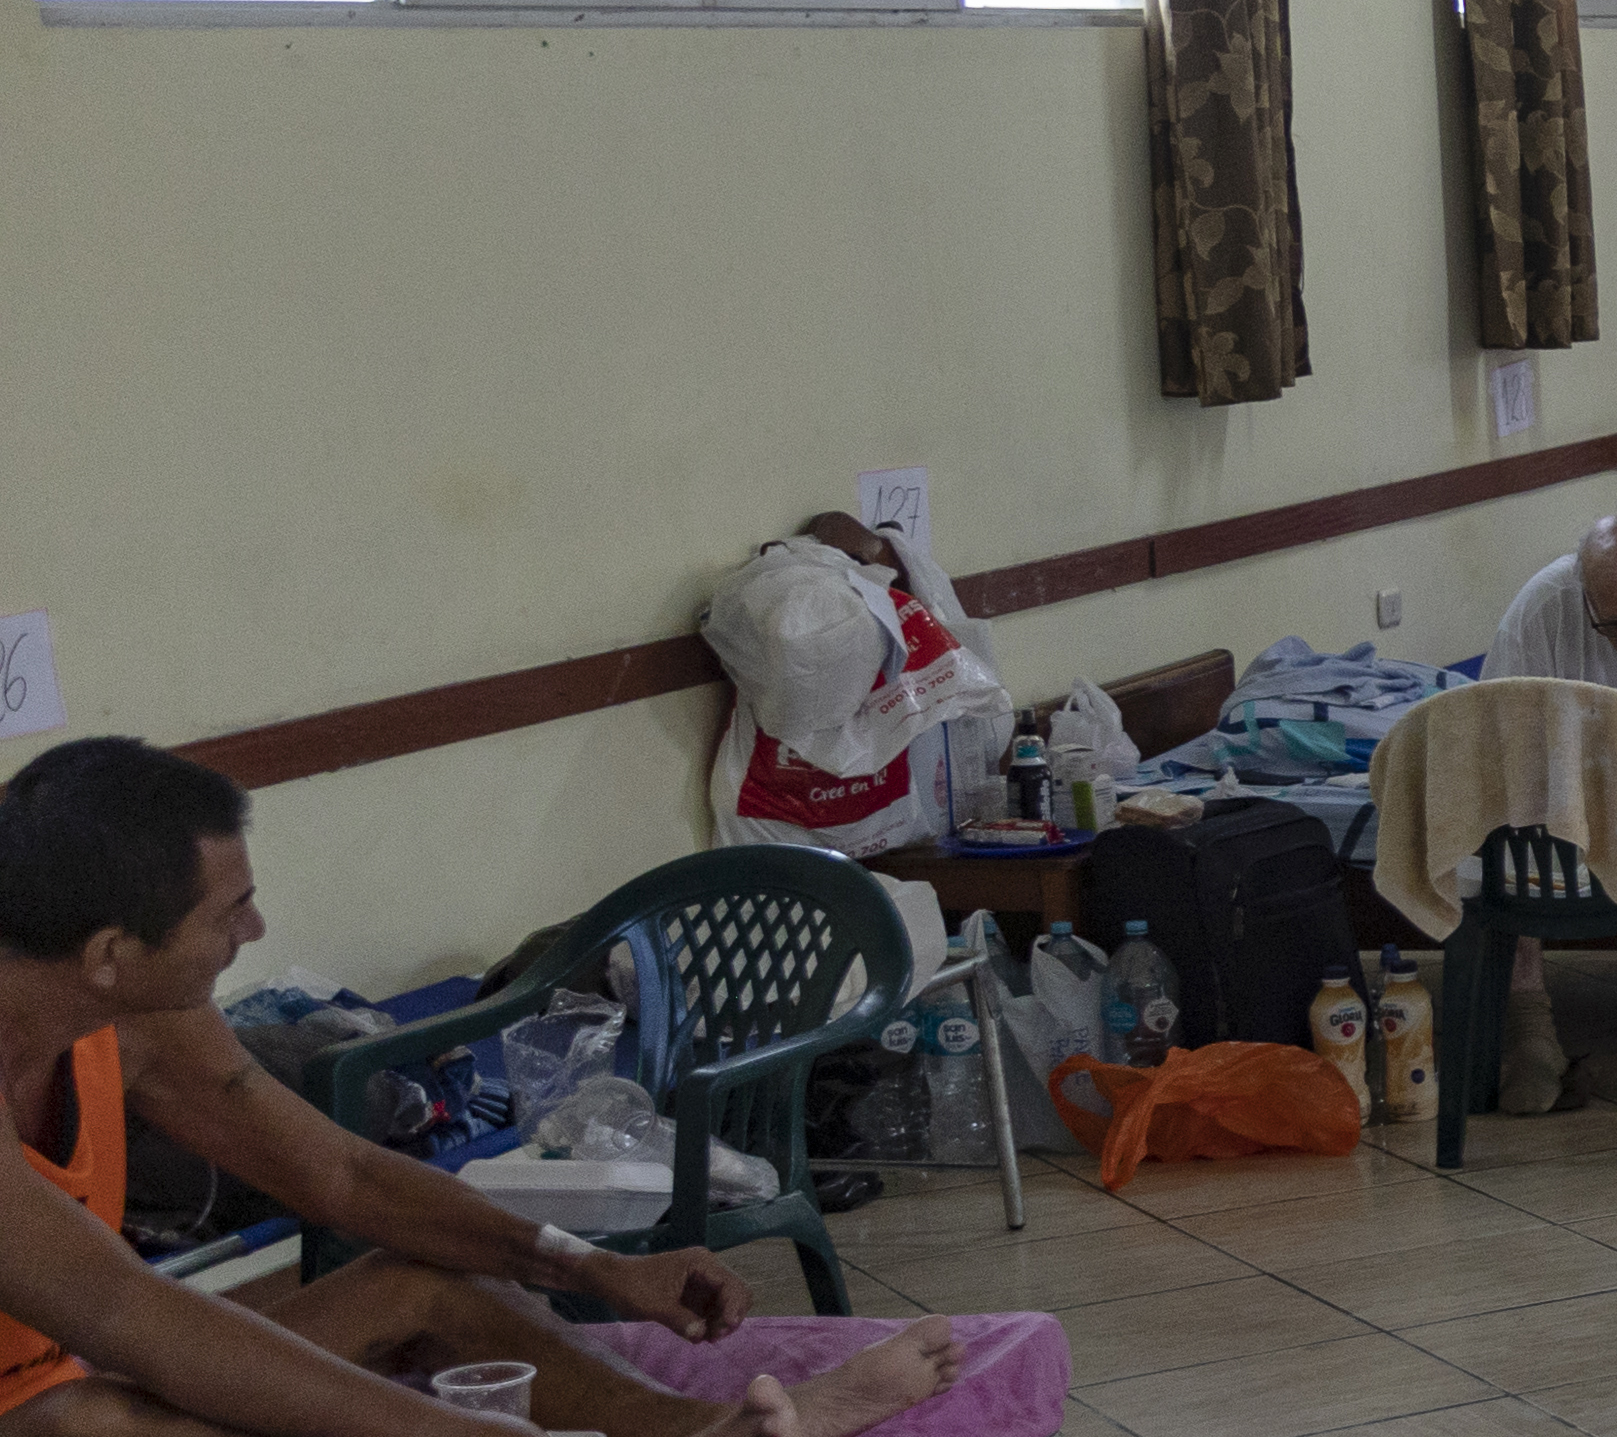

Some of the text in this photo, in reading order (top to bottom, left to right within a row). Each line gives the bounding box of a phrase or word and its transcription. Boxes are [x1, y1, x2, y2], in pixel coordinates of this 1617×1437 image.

[928, 670, 956, 688] 700
[808, 784, 845, 802] Cree
[850, 780, 870, 795] en
[1329, 1010, 1363, 1027] GLORIA
[943, 1024, 966, 1032] san
